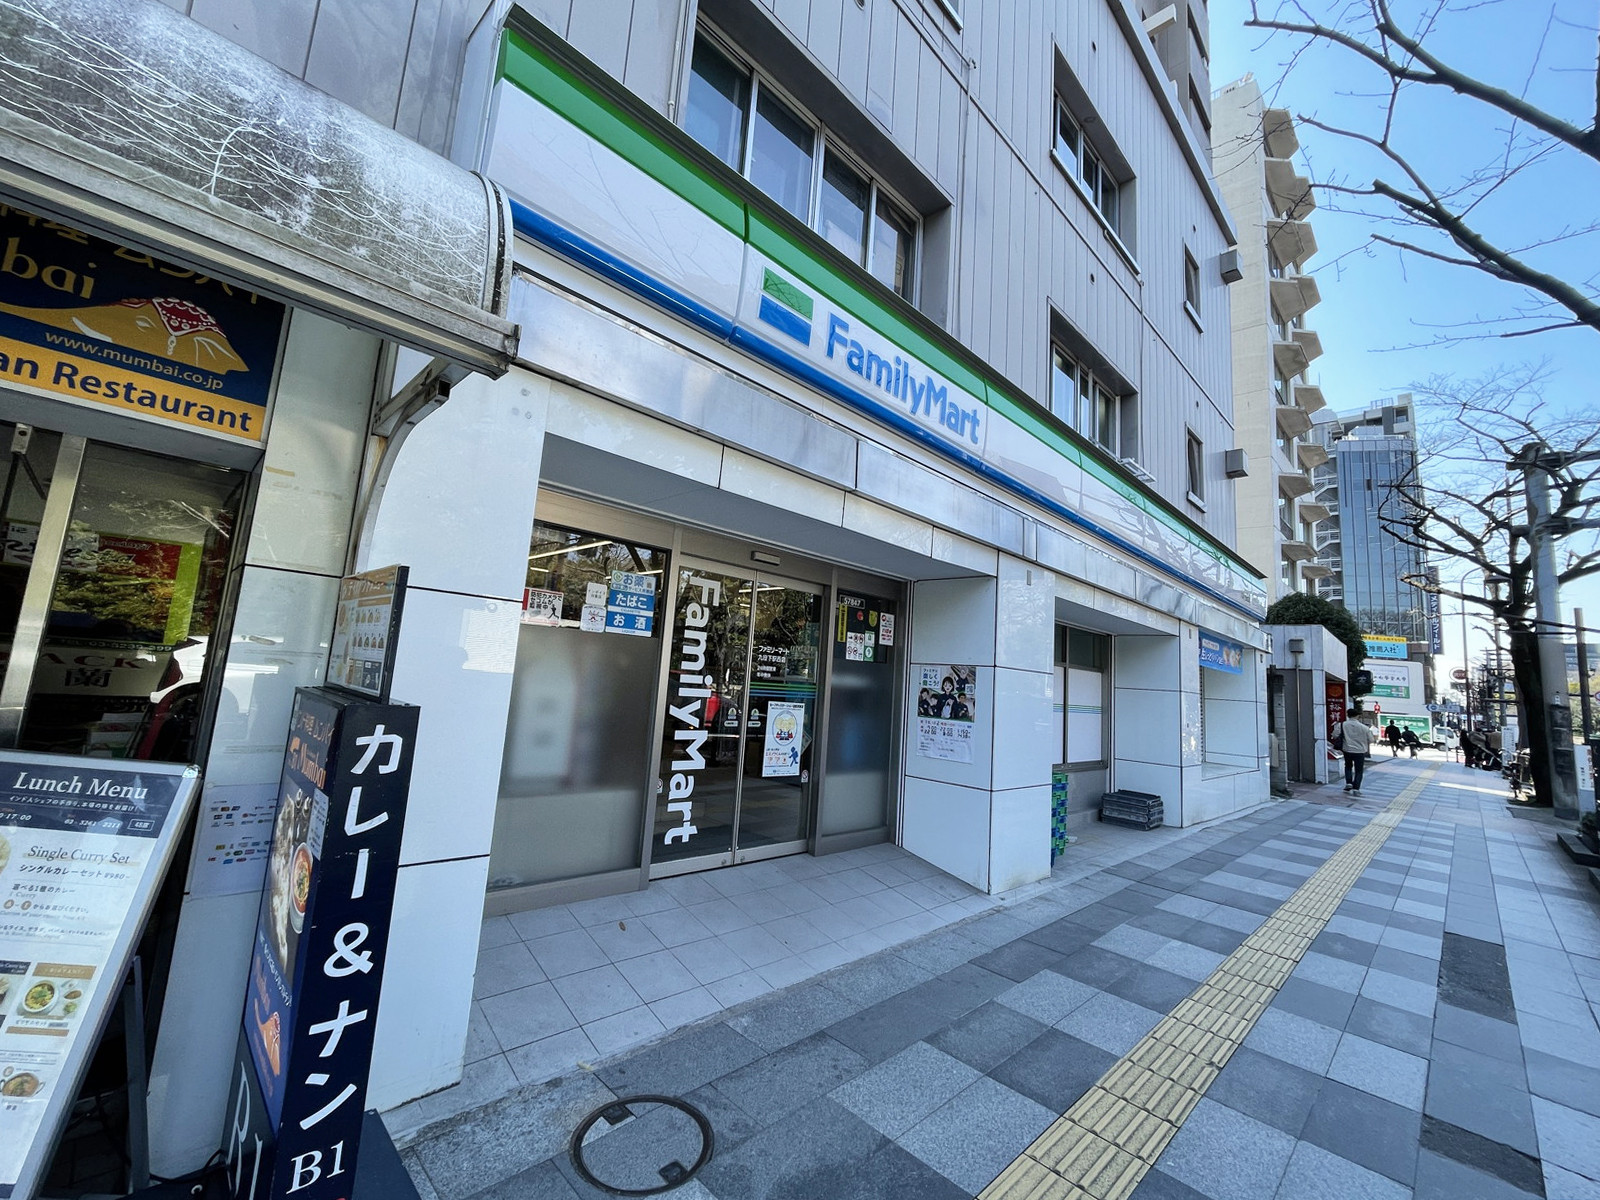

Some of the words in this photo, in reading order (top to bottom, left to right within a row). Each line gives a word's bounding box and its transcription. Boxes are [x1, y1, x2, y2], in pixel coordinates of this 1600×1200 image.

[45, 331, 223, 390] www.mumbai.co.jp
[826, 312, 981, 445] FamilyMart
[52, 361, 252, 432] Restaurant
[615, 593, 647, 609] たばこ
[613, 614, 646, 630] お酒
[758, 645, 790, 655] ファミリーマート
[664, 578, 721, 846] FamilyMart
[13, 772, 82, 795] Lunch
[86, 778, 148, 799] Menu
[20, 864, 102, 877] シングルカレーセット
[28, 846, 68, 861] Single
[71, 849, 107, 864] Curry
[109, 852, 130, 864] Set
[300, 724, 403, 1130] カレー&ナン
[286, 1140, 345, 1194] B1
